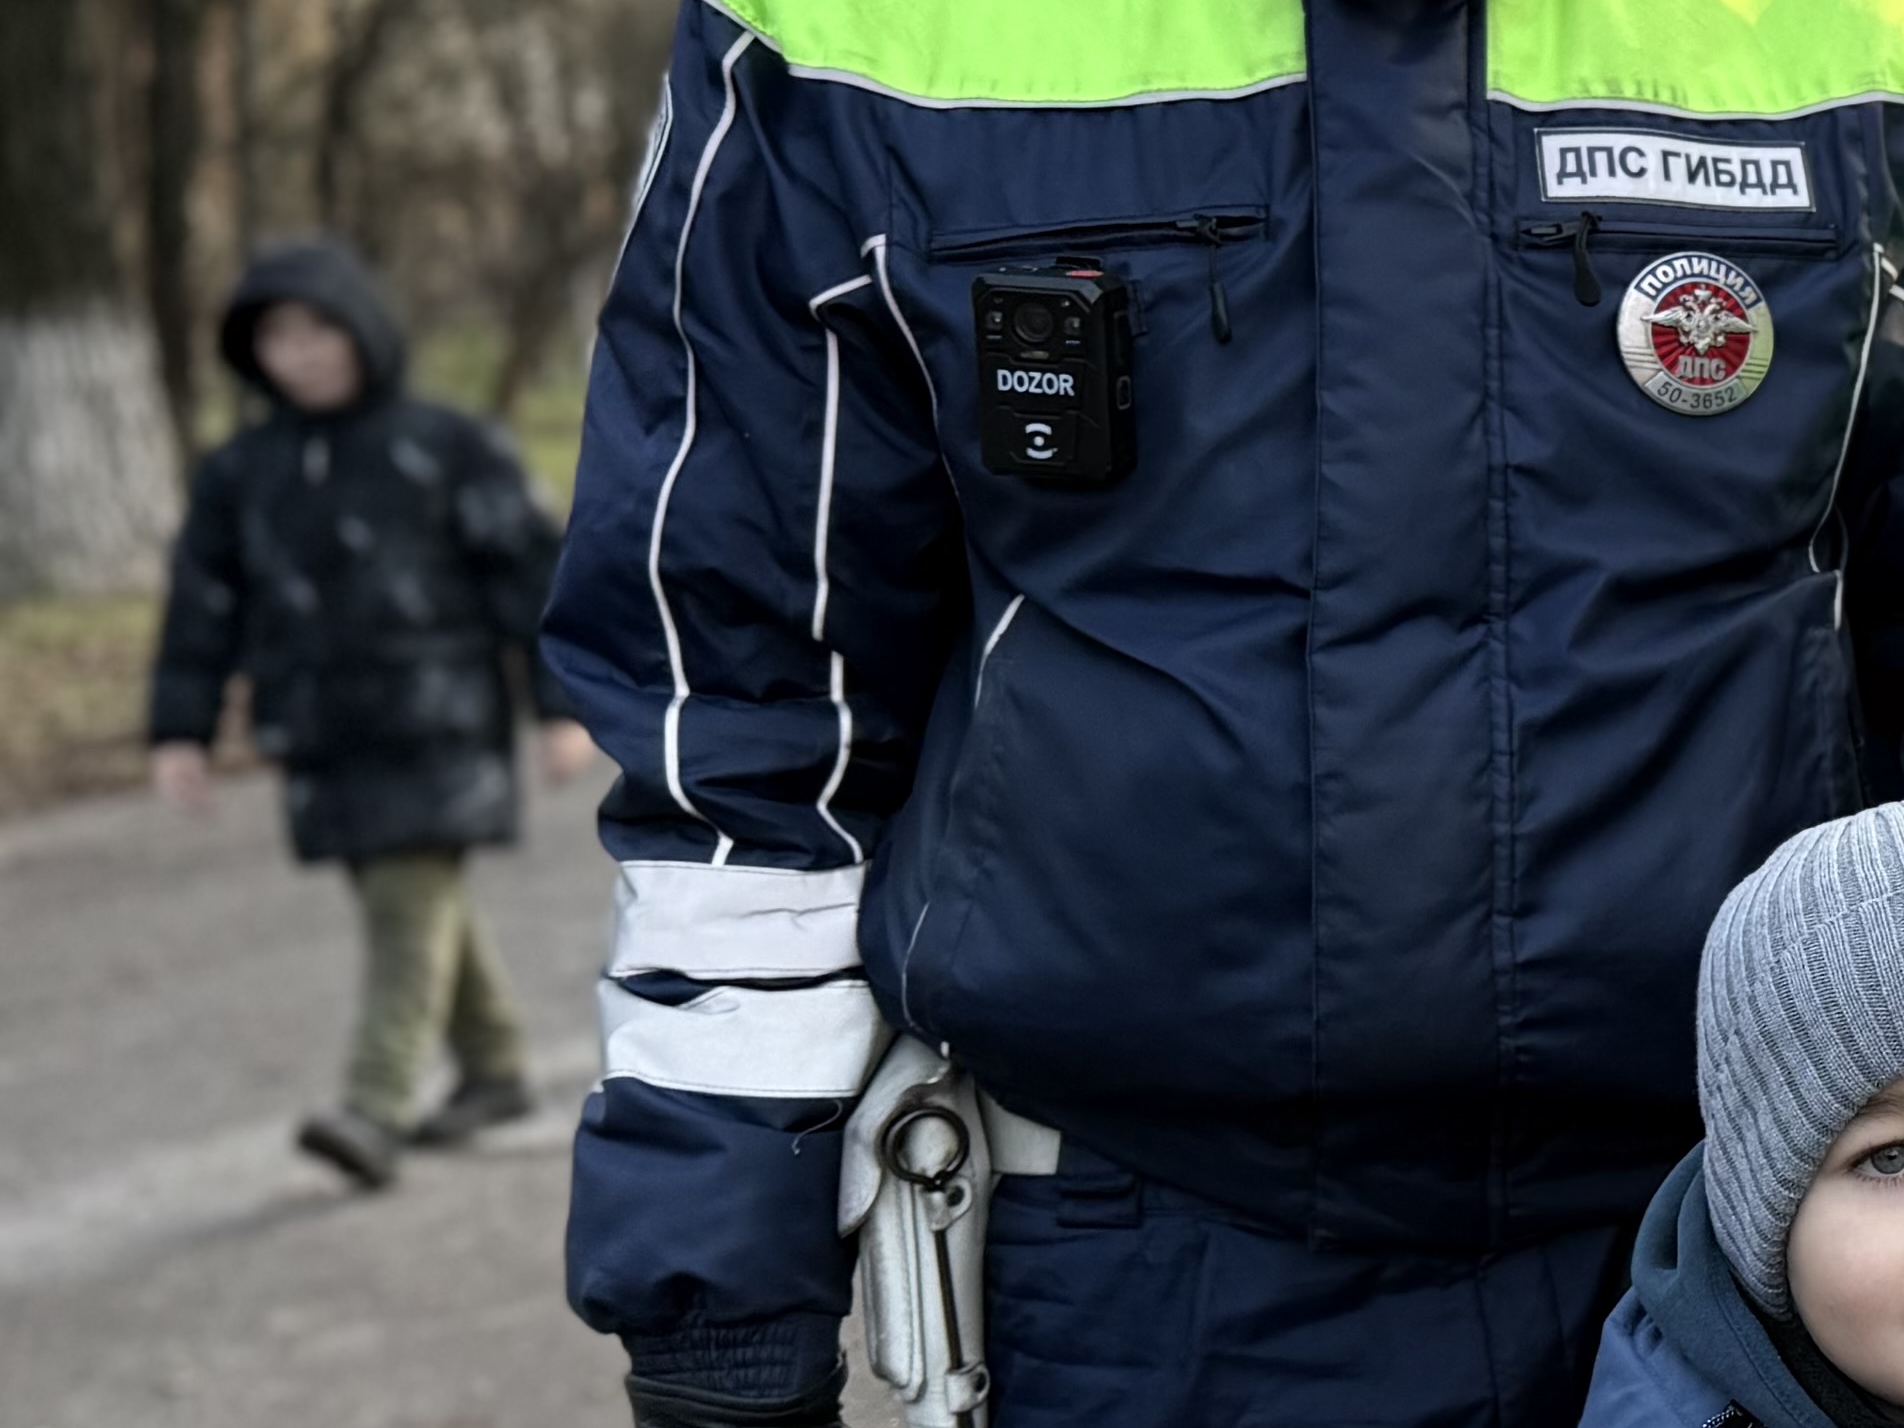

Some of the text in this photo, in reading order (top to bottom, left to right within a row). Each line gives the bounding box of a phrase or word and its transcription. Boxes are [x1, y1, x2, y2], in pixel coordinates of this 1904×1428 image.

[1556, 145, 1798, 195] ДПС ГИБДД
[1639, 256, 1758, 304] ПОЛИЦИЯ
[1677, 355, 1726, 381] ДПС
[996, 369, 1075, 397] DOZOR
[1657, 380, 1737, 409] 50-3652
